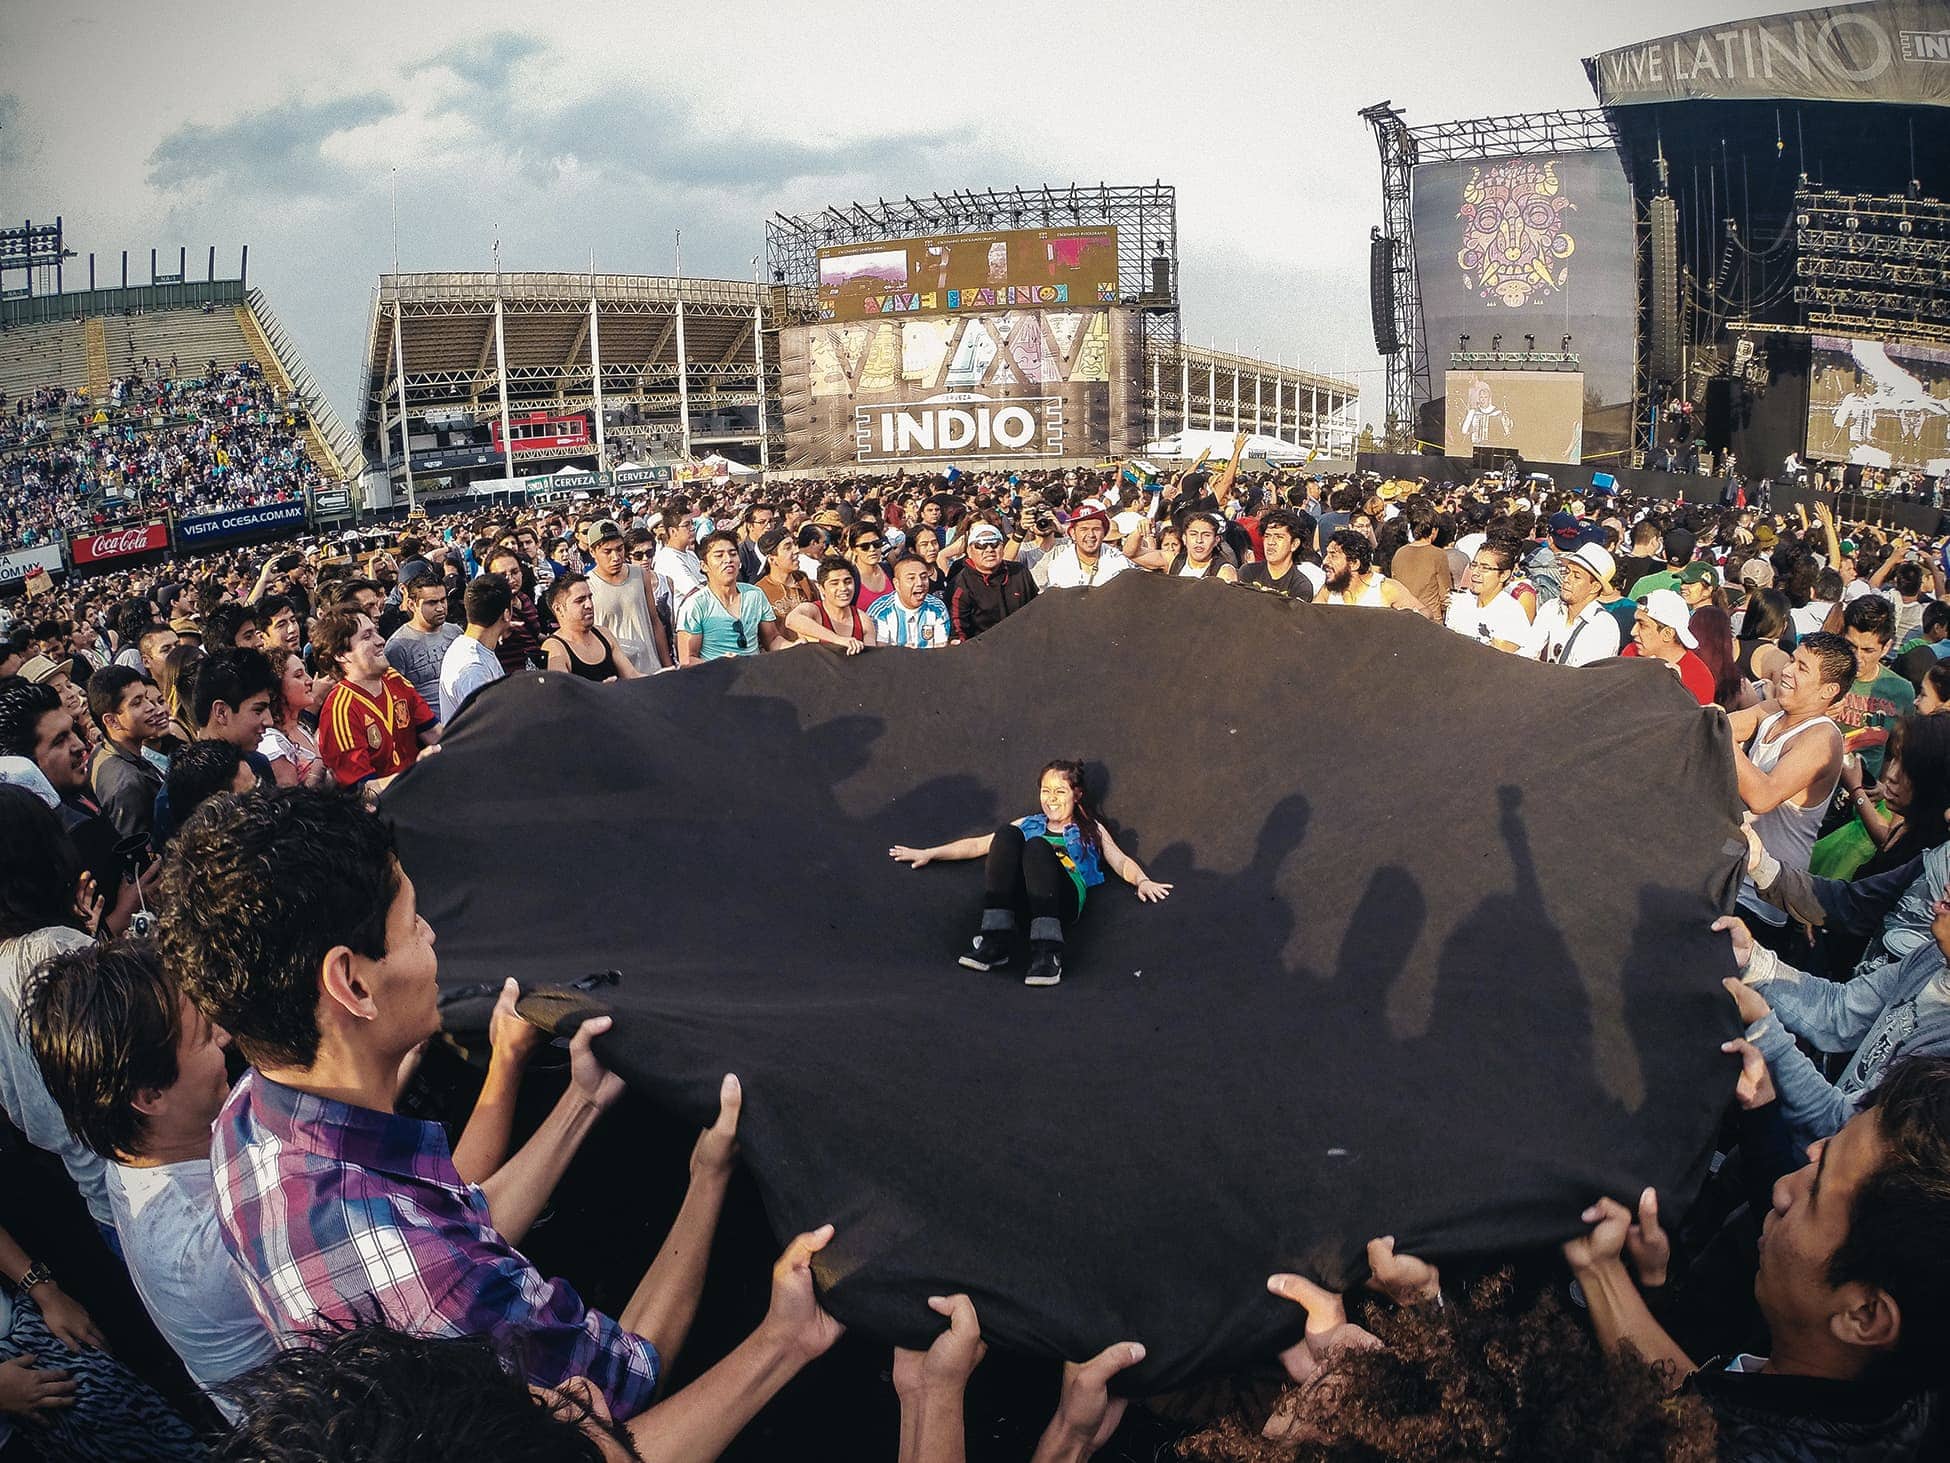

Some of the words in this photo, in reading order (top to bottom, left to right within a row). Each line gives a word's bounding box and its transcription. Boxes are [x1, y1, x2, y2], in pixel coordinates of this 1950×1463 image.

[1611, 44, 1663, 83] VIVE
[1674, 13, 1892, 81] LATINO
[1914, 36, 1950, 58] IN
[880, 406, 1035, 452] INDIO
[554, 476, 596, 488] CERVEZA
[617, 472, 655, 483] CERVEZA
[184, 520, 220, 536] VISITA
[222, 507, 302, 529] OCESA.COM.MX
